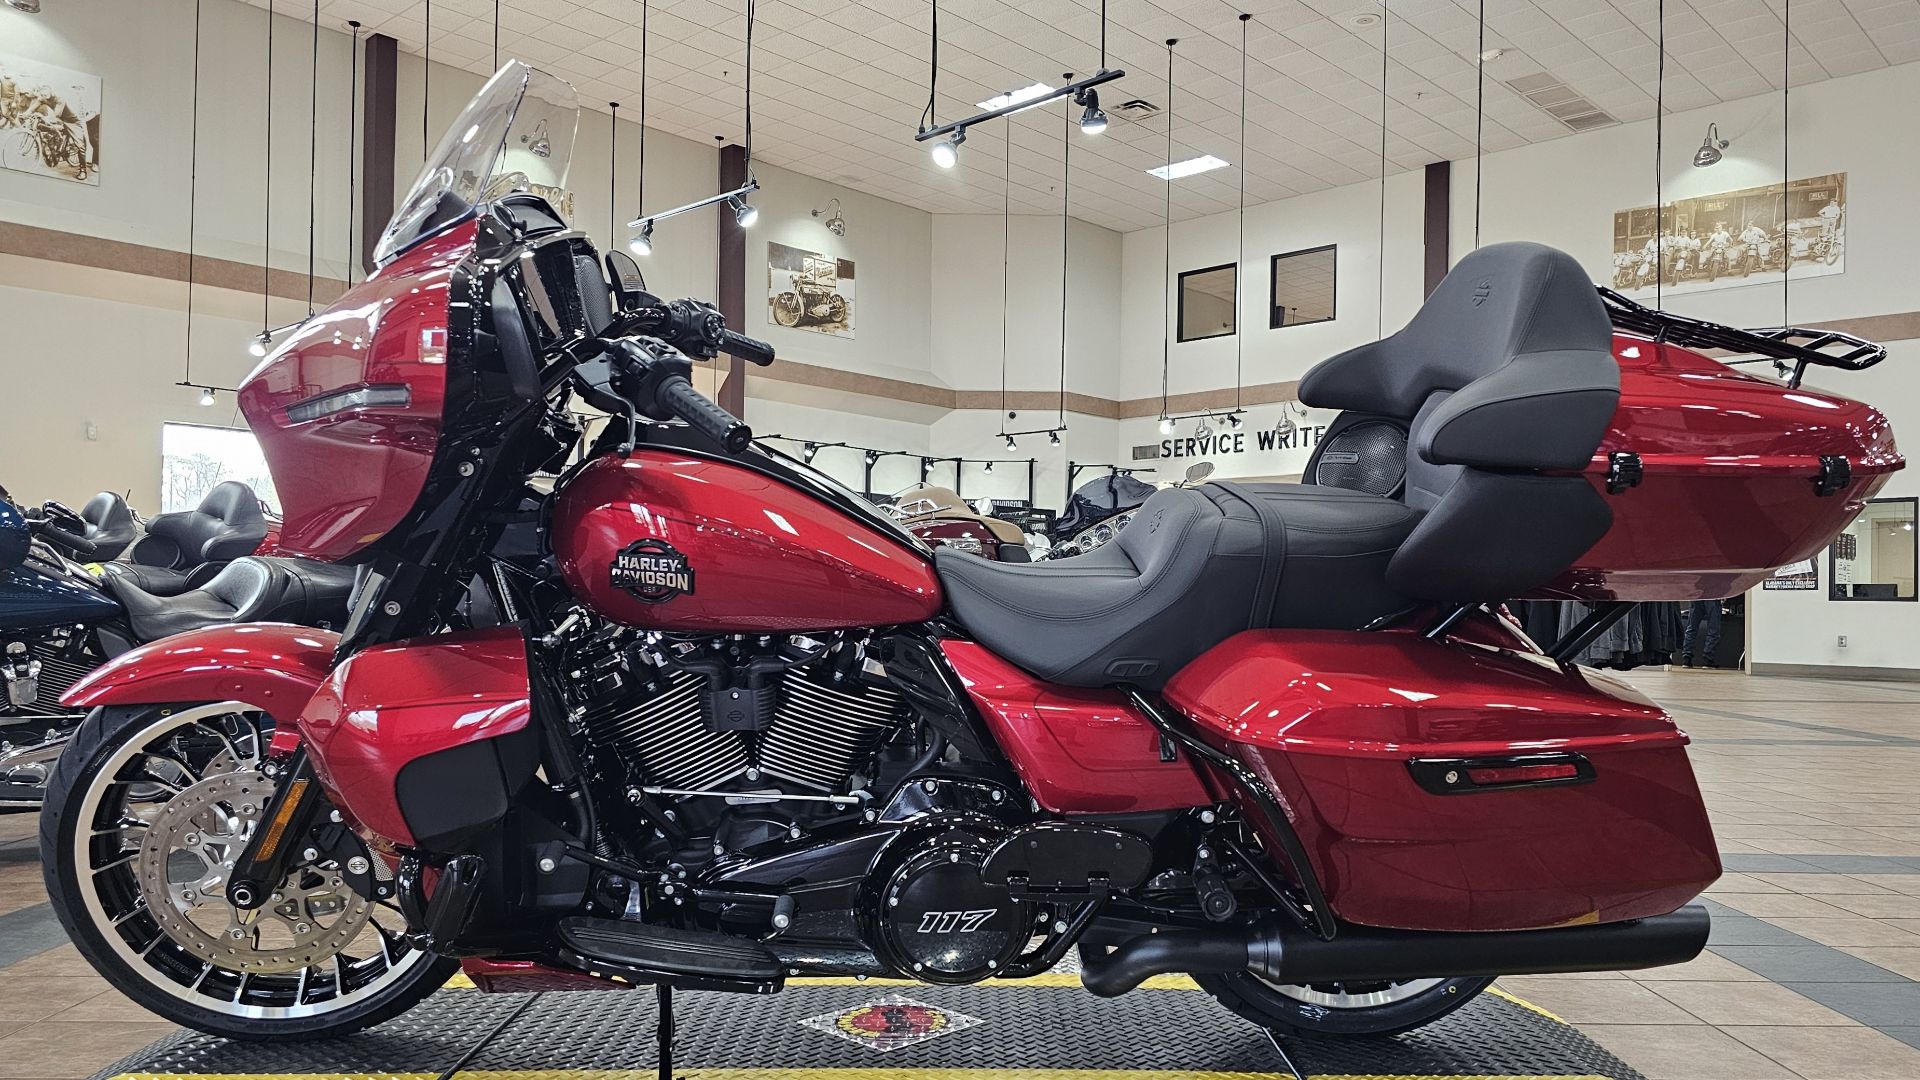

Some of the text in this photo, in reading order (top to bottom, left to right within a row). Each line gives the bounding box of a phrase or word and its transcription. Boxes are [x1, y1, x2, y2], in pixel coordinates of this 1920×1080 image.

[1161, 433, 1244, 458] SERVICE
[611, 568, 689, 591] DAVIDSON
[917, 909, 997, 933] 117
